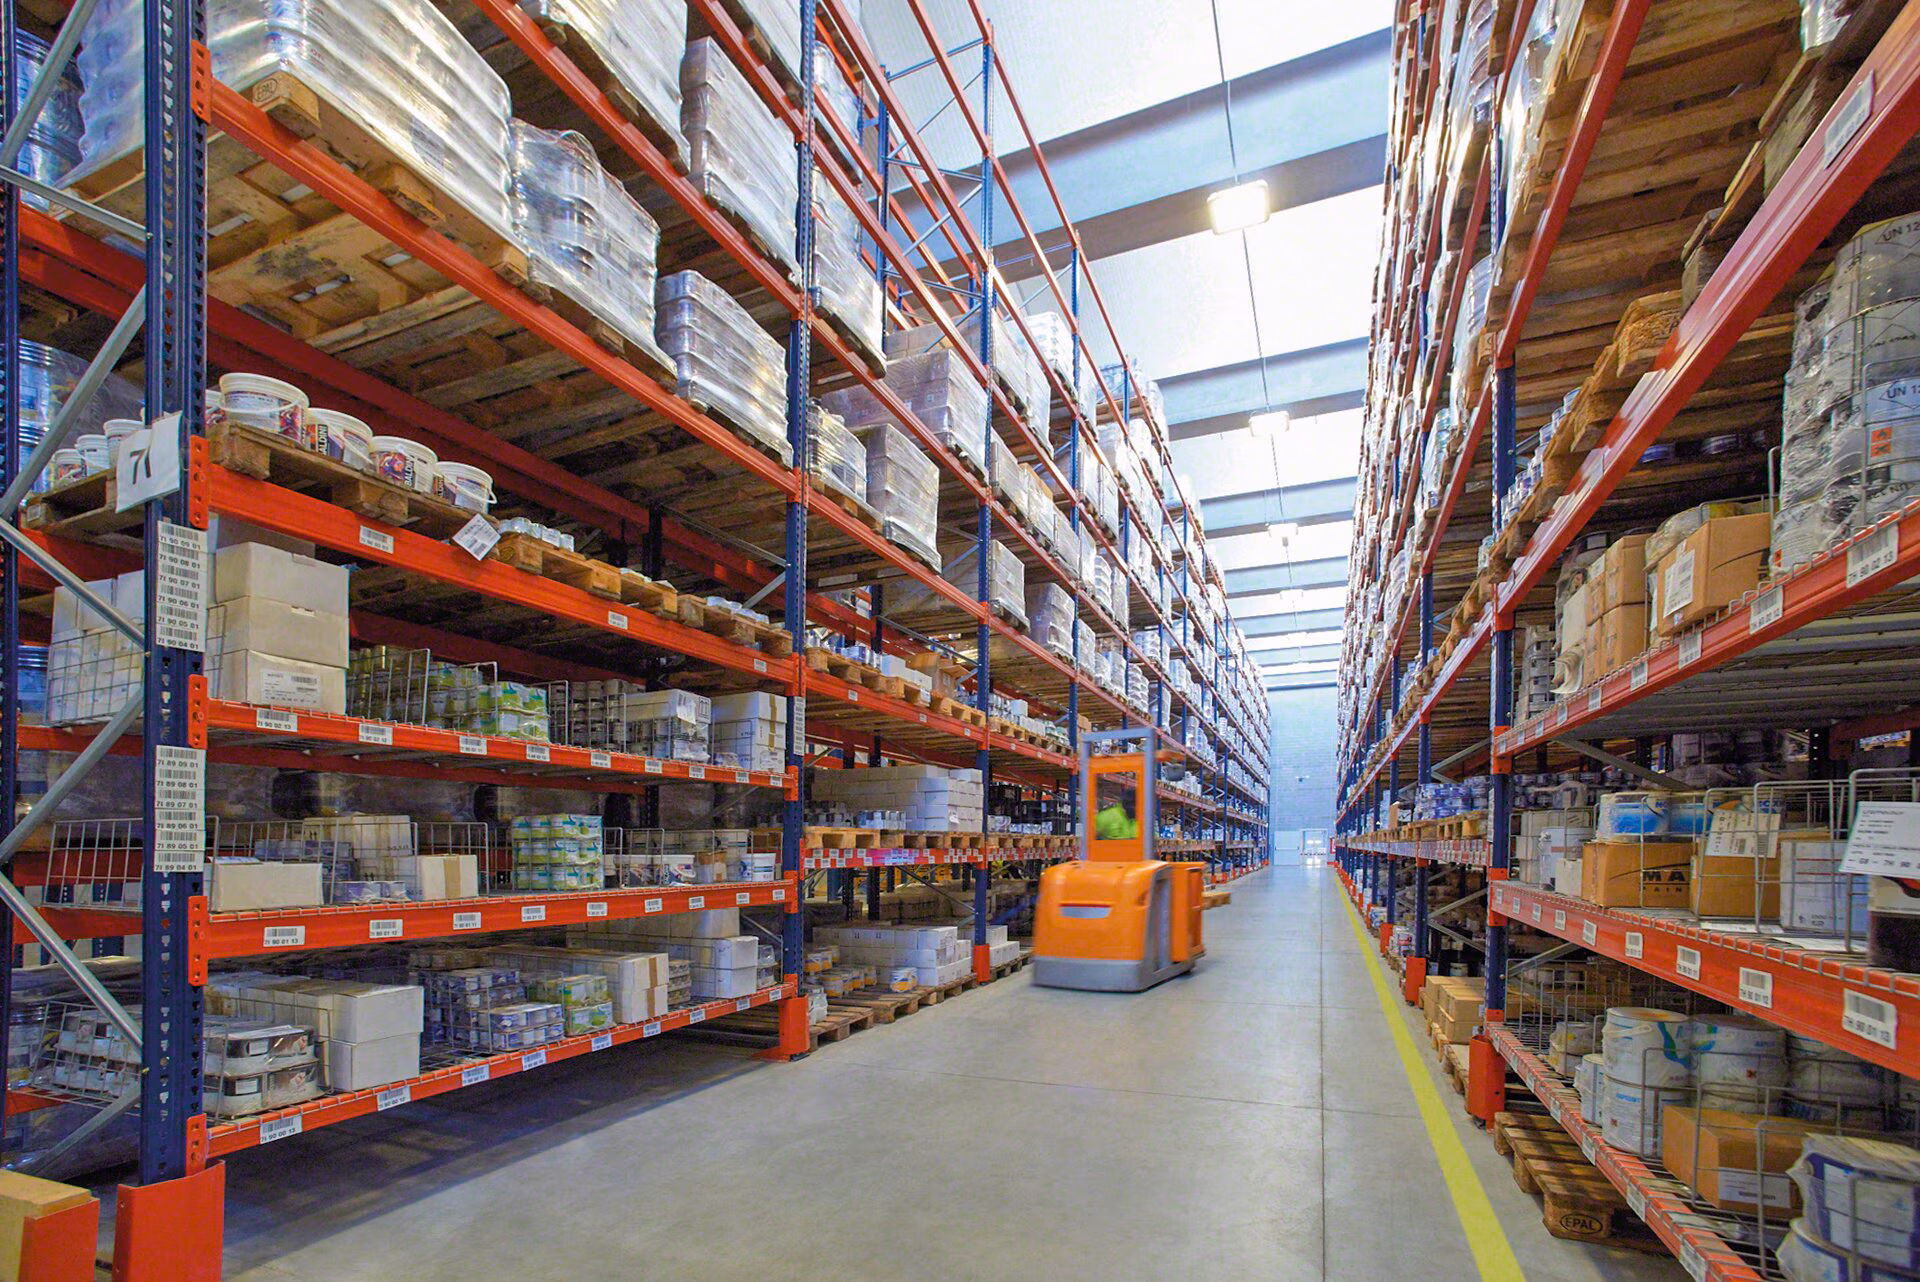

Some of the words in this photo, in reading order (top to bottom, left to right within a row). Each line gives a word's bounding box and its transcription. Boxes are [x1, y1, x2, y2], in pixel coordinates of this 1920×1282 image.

[1882, 226, 1903, 241] UN
[1887, 387, 1907, 399] UN
[318, 425, 328, 456] ALDINI
[129, 447, 151, 485] 71
[1565, 1217, 1596, 1231] EPAL
